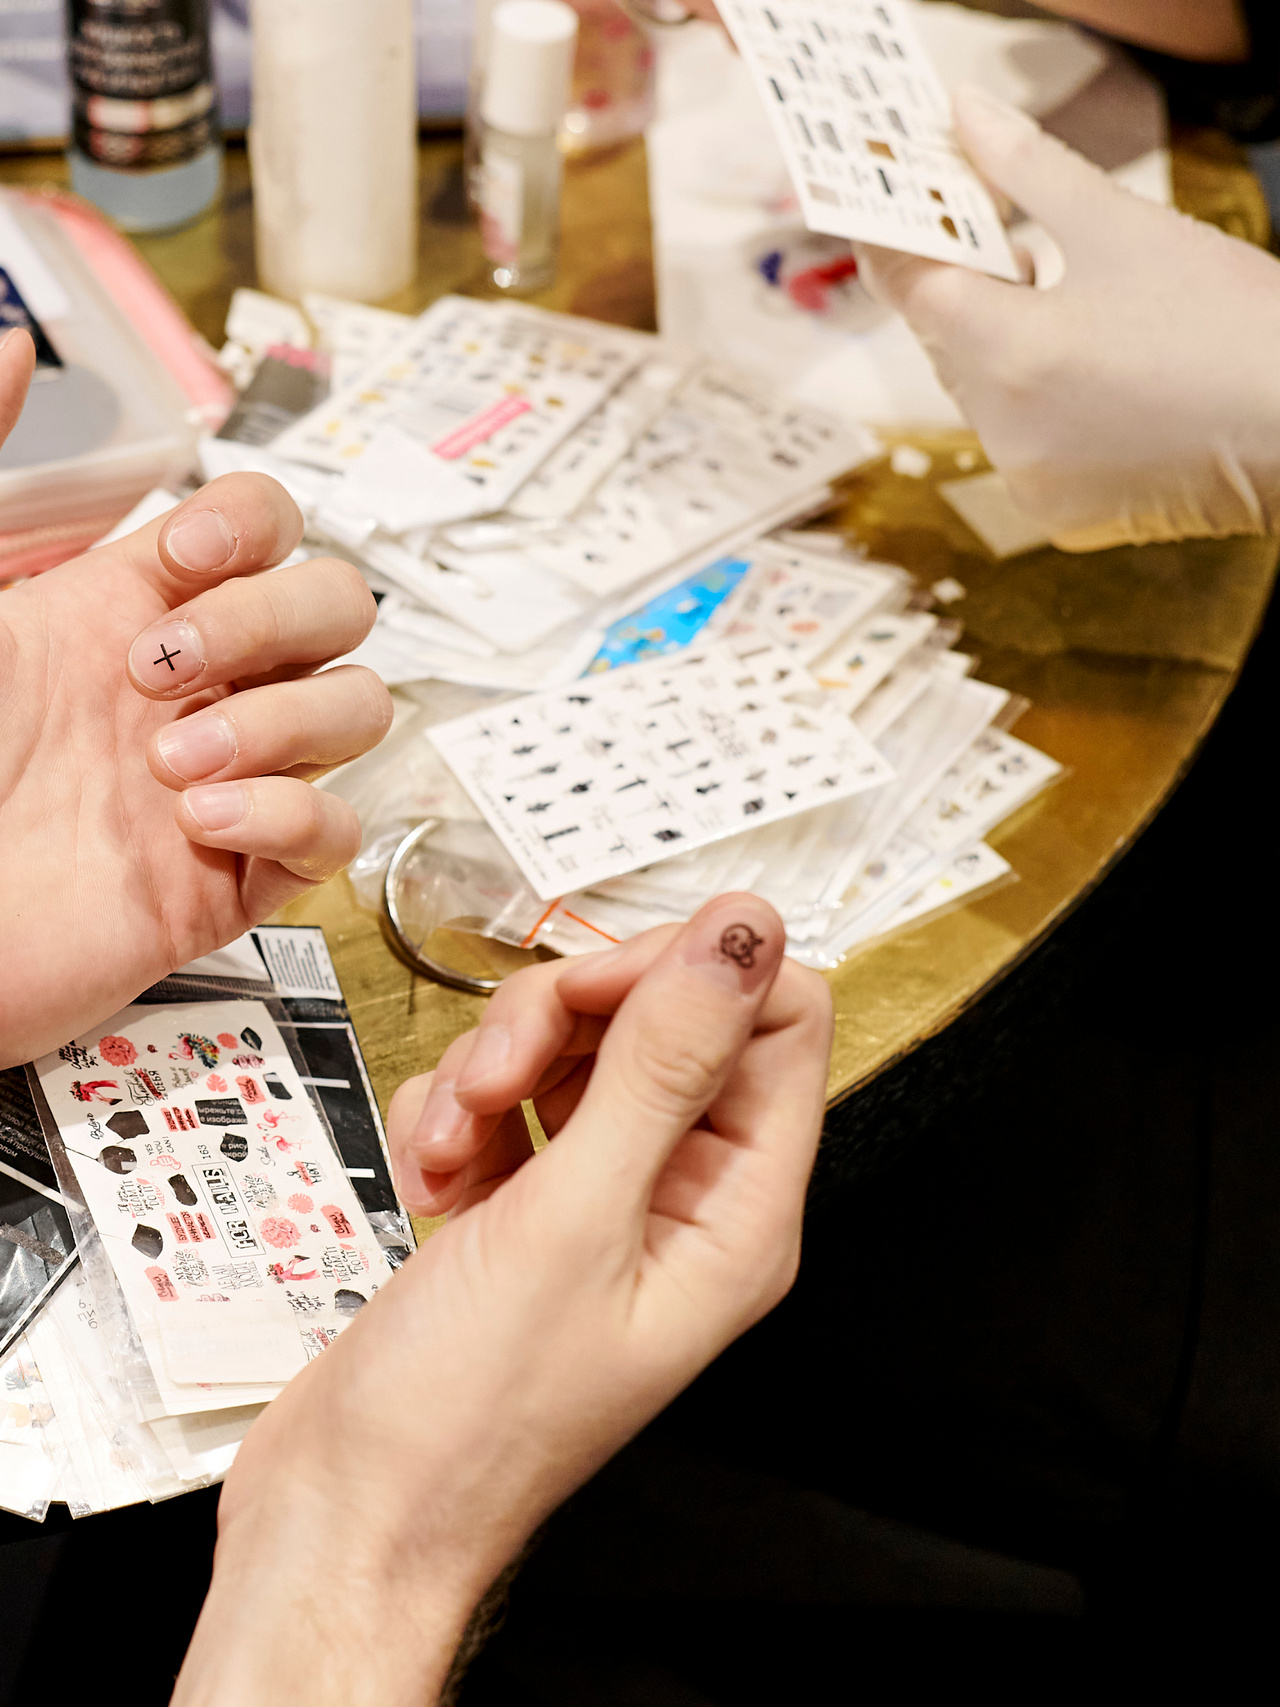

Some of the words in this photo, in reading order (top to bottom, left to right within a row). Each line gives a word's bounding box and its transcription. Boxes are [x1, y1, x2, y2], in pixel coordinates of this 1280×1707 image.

[148, 1070, 166, 1094] СЕБЯ
[144, 1143, 154, 1157] YES
[153, 1140, 165, 1154] YOU
[197, 1144, 211, 1160] 163
[142, 1185, 154, 1193] IT
[202, 1168, 238, 1215] NAILS
[124, 1190, 146, 1217] DREAM
[146, 1195, 160, 1206] DO
[226, 1220, 257, 1249] FOR
[184, 1253, 195, 1262] IS
[172, 1266, 184, 1280] MY
[189, 1265, 202, 1280] AGE
